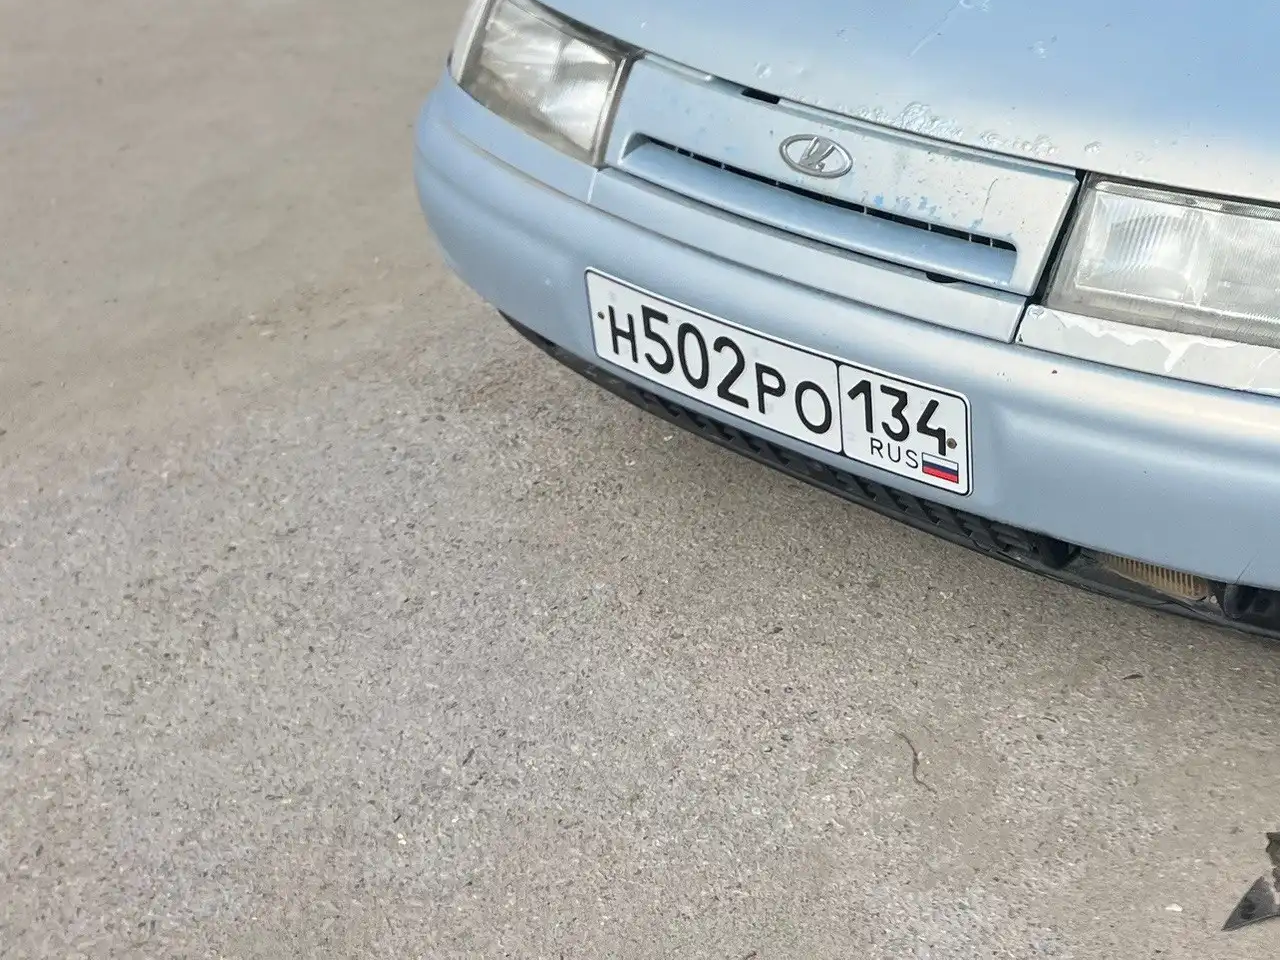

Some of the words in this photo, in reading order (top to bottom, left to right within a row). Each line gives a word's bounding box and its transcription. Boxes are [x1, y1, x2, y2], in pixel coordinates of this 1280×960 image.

[608, 304, 833, 435] Н502РО
[847, 379, 948, 456] 134
[869, 436, 919, 470] RUS
